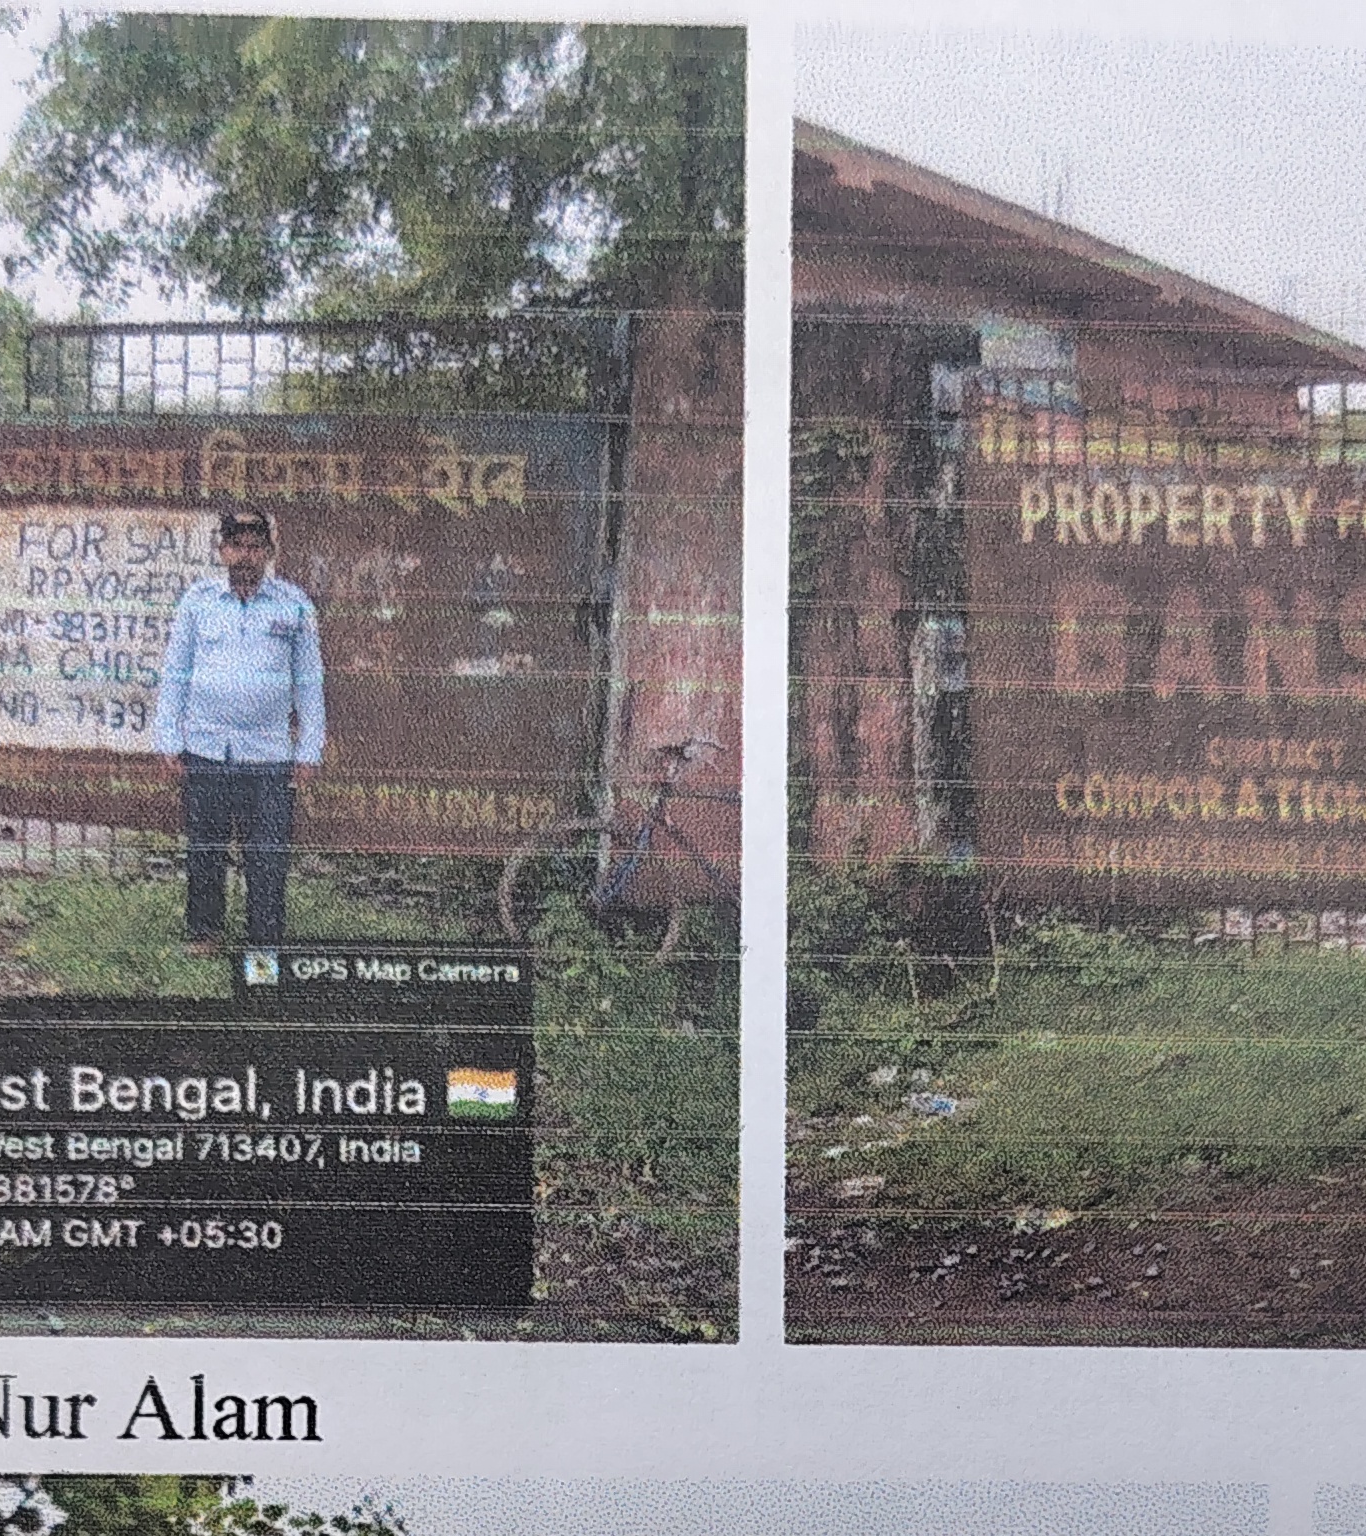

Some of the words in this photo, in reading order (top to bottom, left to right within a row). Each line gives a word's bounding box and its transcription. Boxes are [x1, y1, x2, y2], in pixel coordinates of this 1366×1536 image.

[18, 520, 110, 562] FOR
[126, 523, 225, 566] SALE
[1021, 483, 1319, 549] PROPERTY
[57, 649, 161, 688] GHOS
[119, 1373, 325, 1445] Alam
